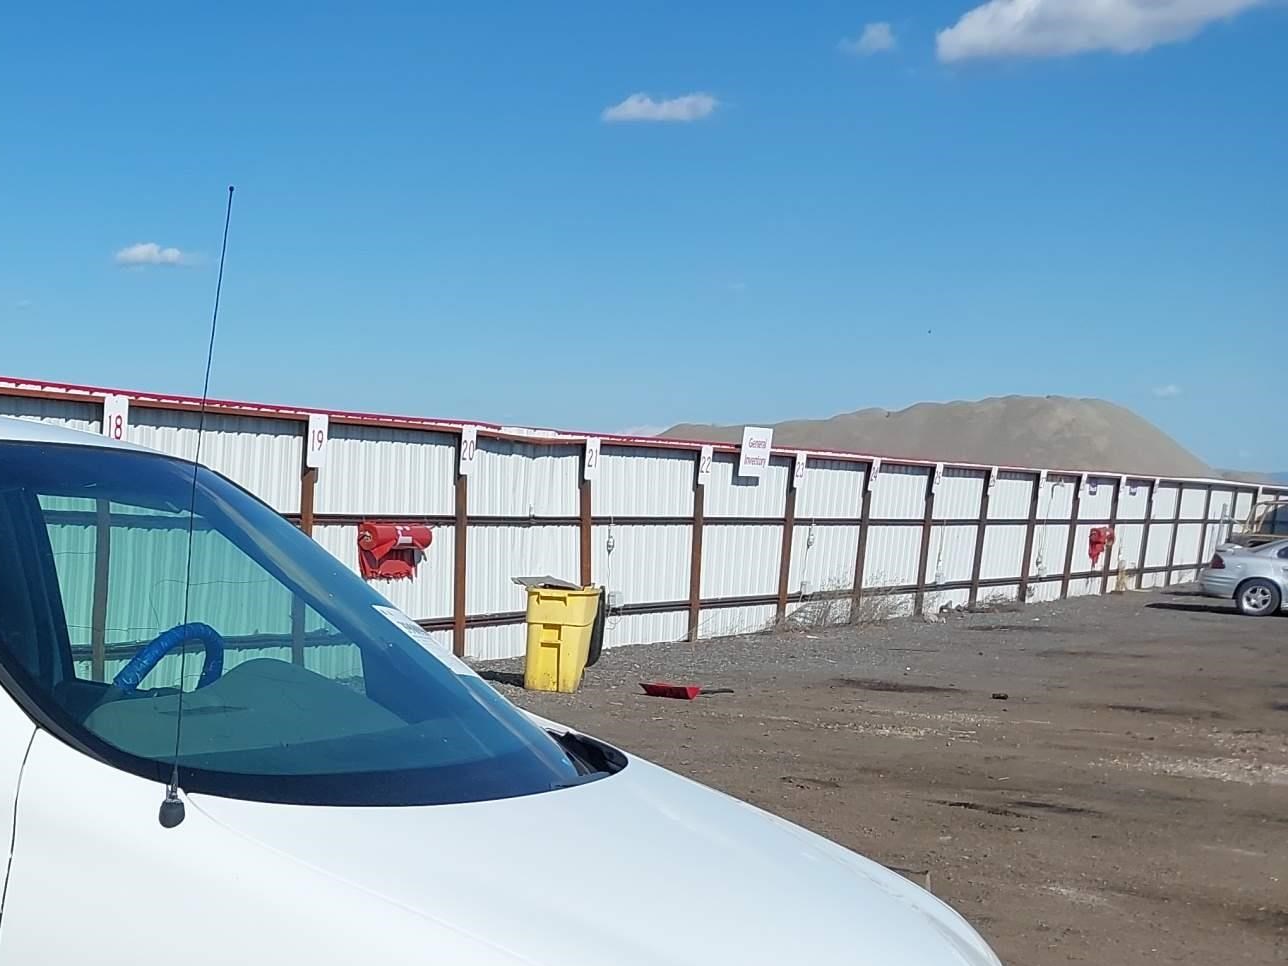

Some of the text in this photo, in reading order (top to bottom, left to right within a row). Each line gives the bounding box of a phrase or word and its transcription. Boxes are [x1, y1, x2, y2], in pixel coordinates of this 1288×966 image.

[108, 414, 123, 440] 18
[311, 429, 324, 451] 19
[462, 439, 475, 461] 20
[587, 449, 598, 468] 21
[699, 456, 711, 473] 22
